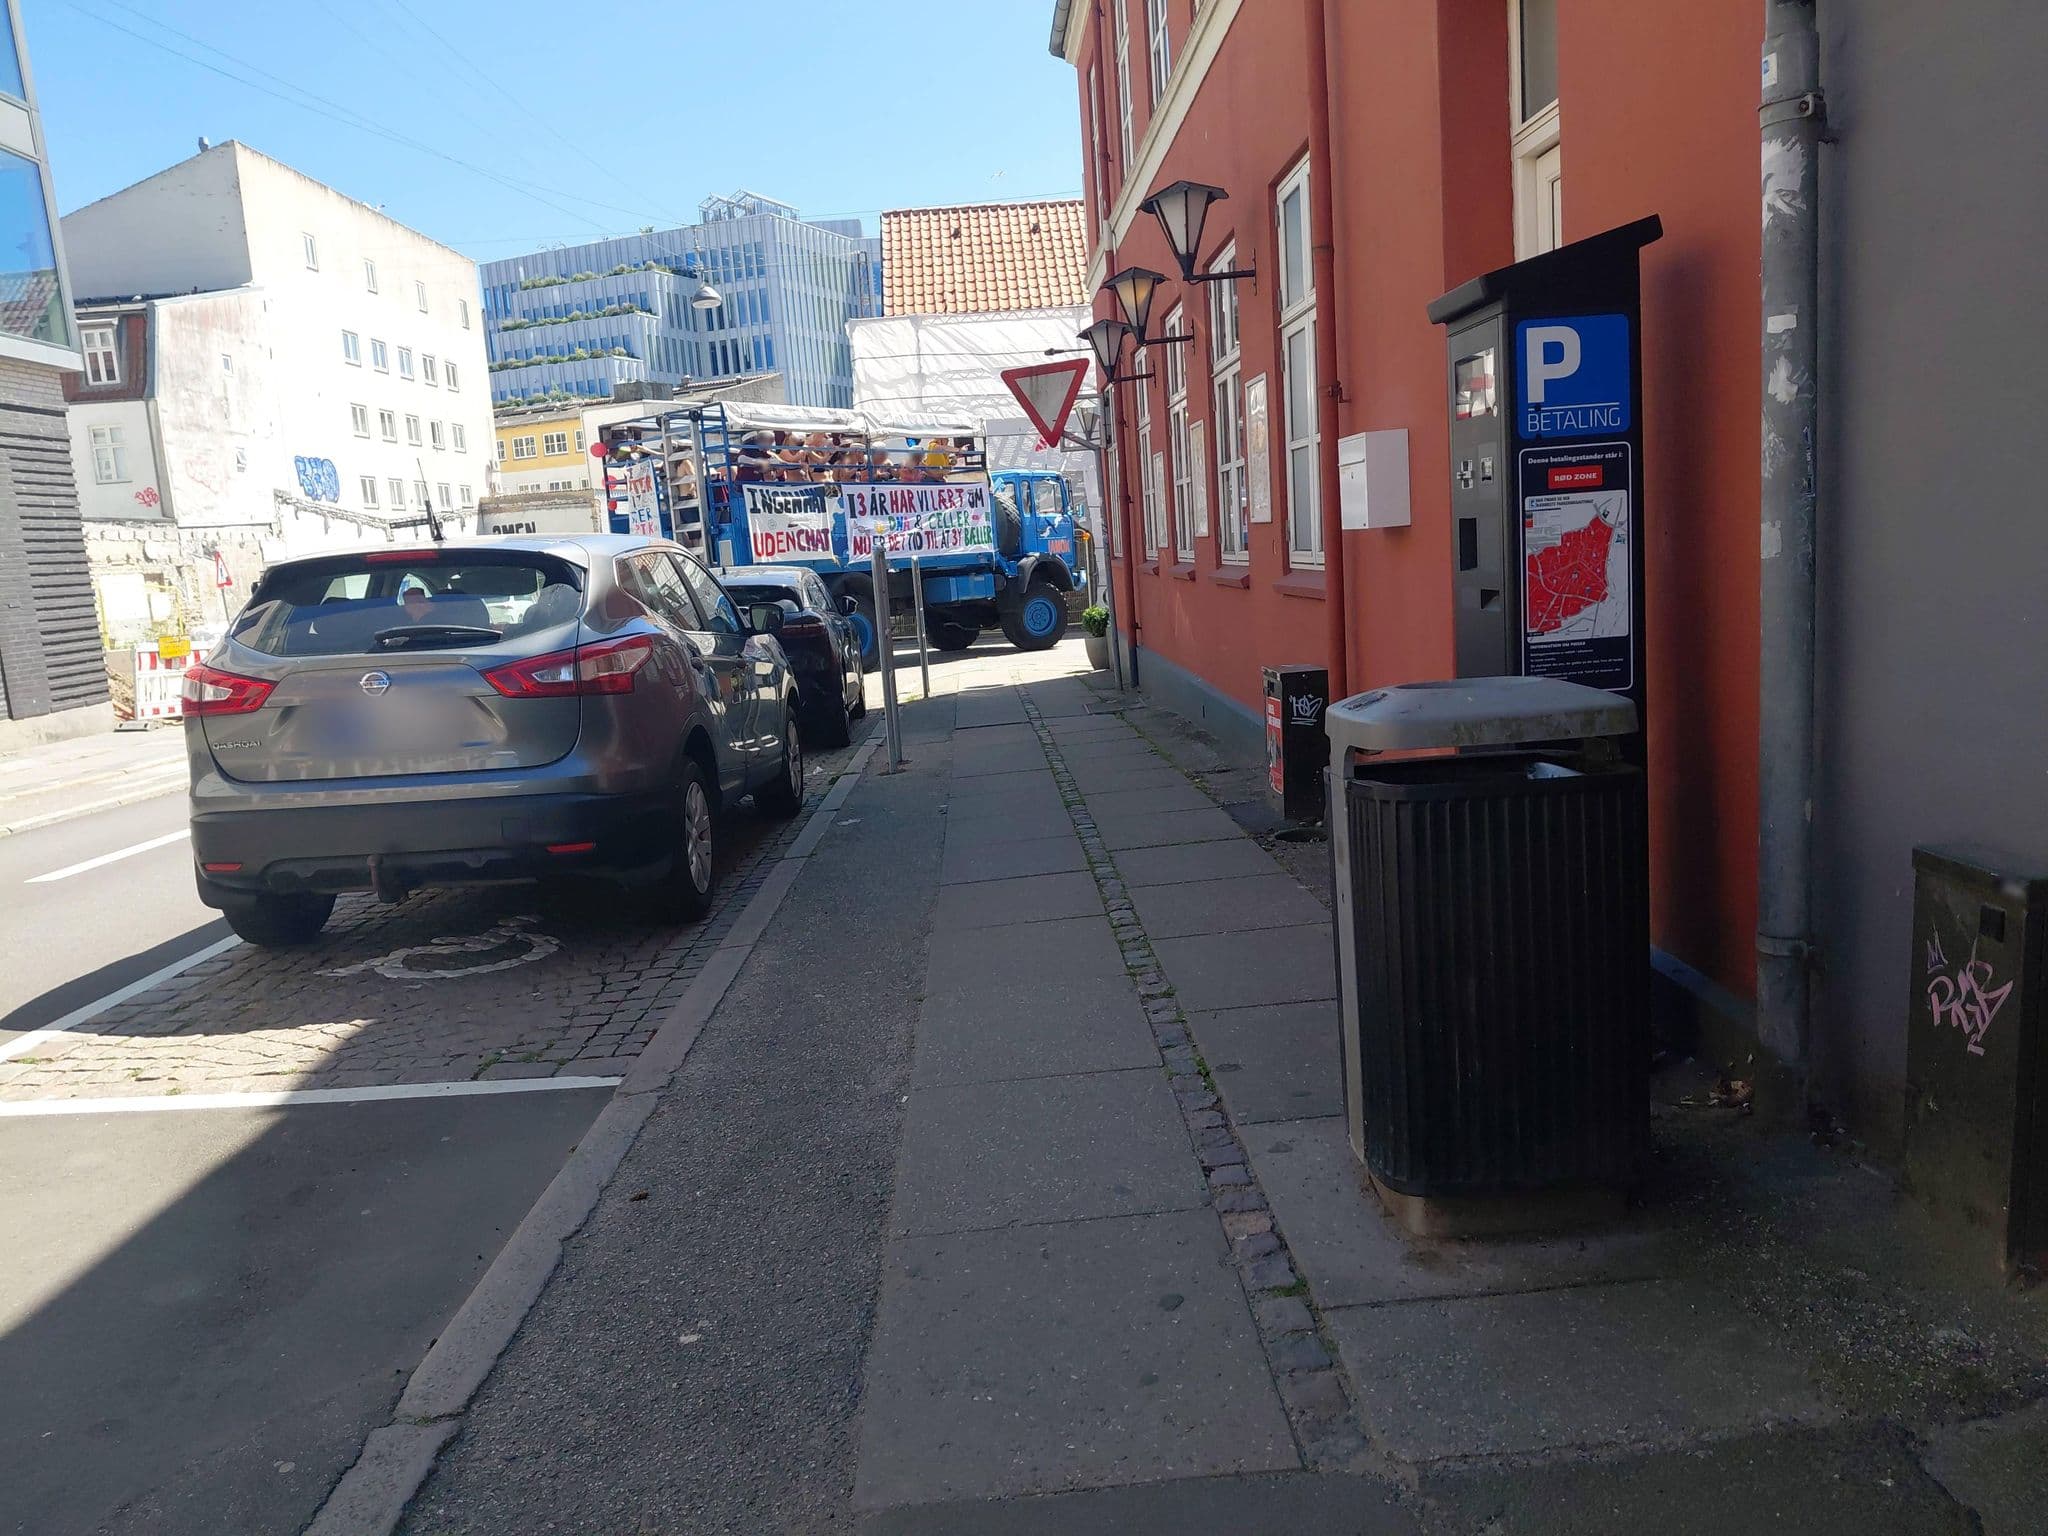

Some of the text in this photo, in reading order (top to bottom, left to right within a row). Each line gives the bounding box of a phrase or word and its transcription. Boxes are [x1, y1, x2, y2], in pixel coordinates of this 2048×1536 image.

[1526, 326, 1581, 403] P
[1527, 407, 1621, 432] BETALING
[1528, 457, 1549, 465] Denne
[1549, 452, 1604, 463] betalingsstander
[1554, 472, 1598, 482] RØD ZONE
[857, 492, 867, 517] 3
[870, 486, 890, 516] ÅR
[890, 489, 917, 514] HAR
[916, 490, 930, 512] VI
[930, 488, 965, 512] LÆRT
[888, 510, 970, 532] DNA & CELLER
[753, 527, 830, 557] UDEN CHAT
[853, 535, 872, 556] NU
[888, 533, 906, 551] DET
[908, 531, 923, 551] TID
[925, 530, 939, 549] TIL
[941, 529, 950, 549] AT
